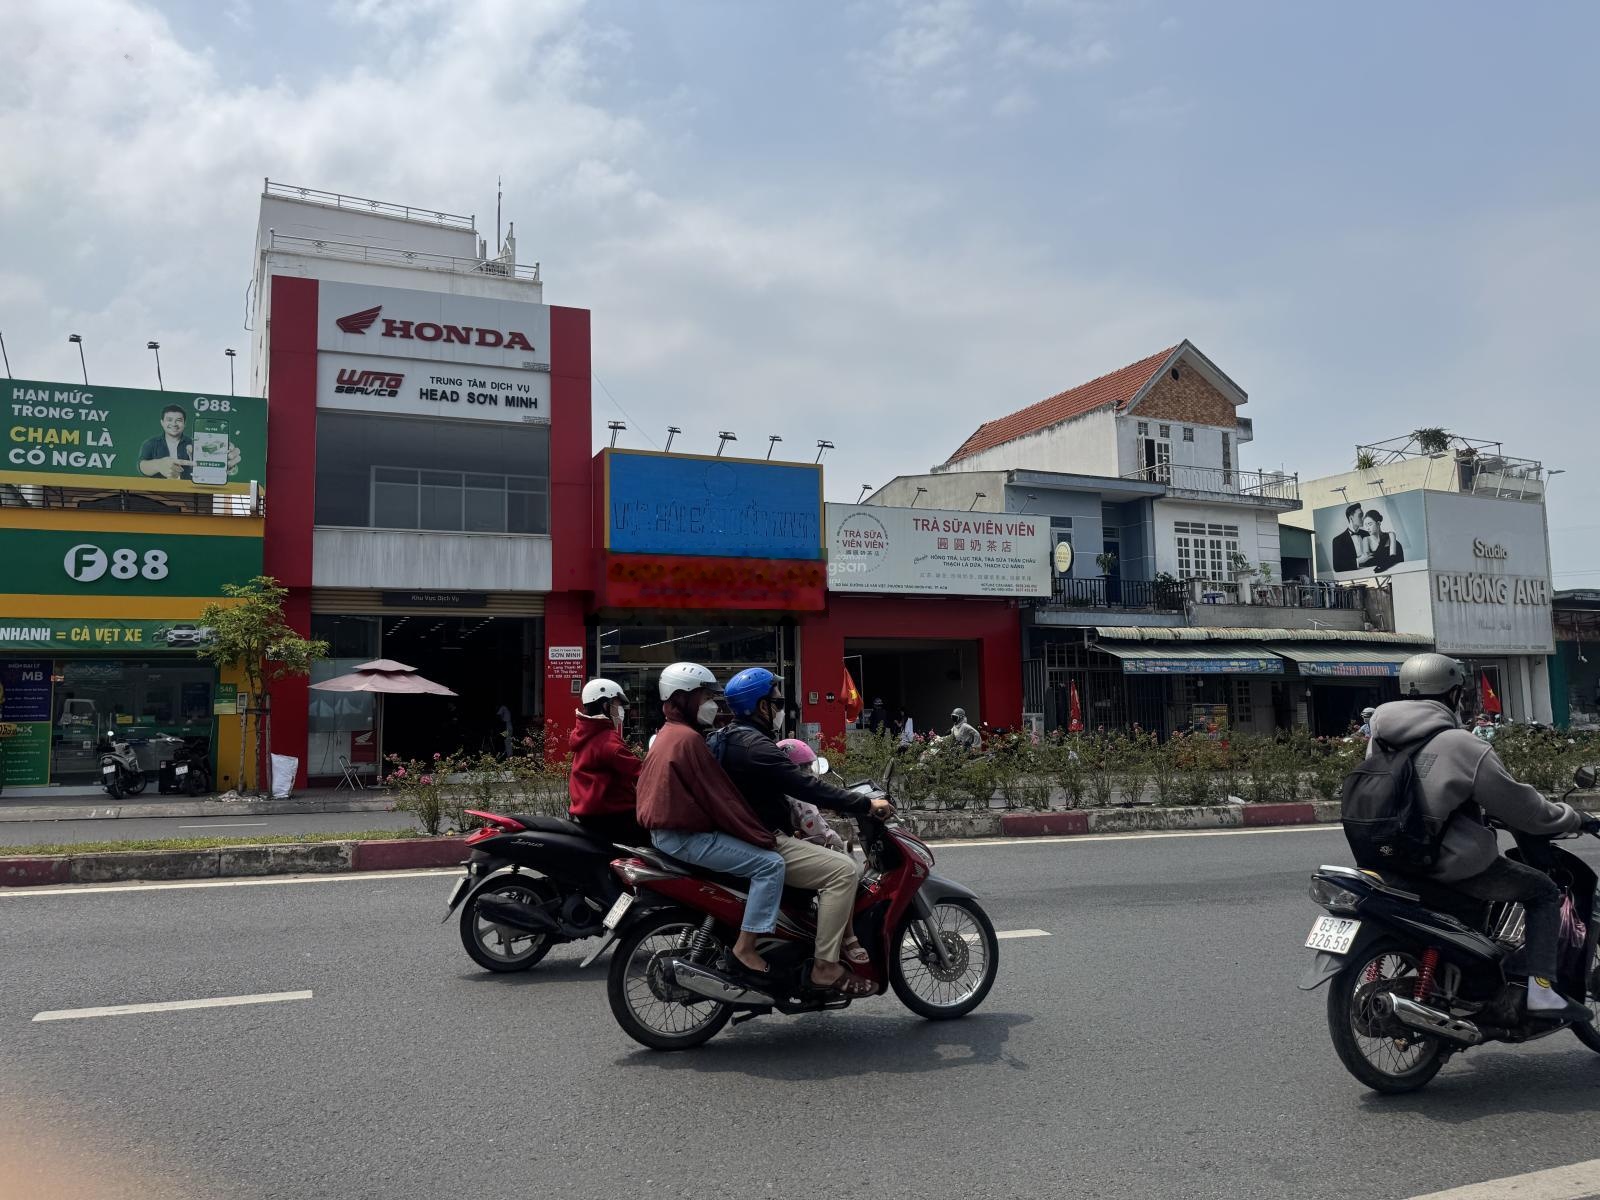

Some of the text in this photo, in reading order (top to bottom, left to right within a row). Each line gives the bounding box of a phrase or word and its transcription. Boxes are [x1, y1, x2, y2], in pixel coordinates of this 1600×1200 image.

[381, 318, 535, 351] HONDA
[429, 376, 530, 393] TRUNG TÂM DỊCH VỤ
[12, 387, 94, 405] HẠN MỨC
[194, 397, 230, 412] F88
[419, 387, 538, 409] HEAD SƠN MINH
[12, 404, 110, 422] TRONG TAY
[10, 425, 113, 449] CHẠM LÀ
[8, 445, 117, 470] CÓ NGAY
[912, 517, 1035, 537] TRÀ SỮA VIÊN VIÊN
[842, 539, 884, 549] VIÊN VIÊN
[1473, 537, 1508, 559] Studio
[64, 544, 168, 582] F88
[1436, 572, 1549, 606] PHƯƠNG ANH
[0, 628, 50, 641] NHANH
[95, 628, 120, 645] VẸT
[121, 628, 142, 642] XE
[22, 671, 44, 681] MB
[1320, 918, 1353, 935] 63-B7
[1309, 932, 1350, 951] 326.58
